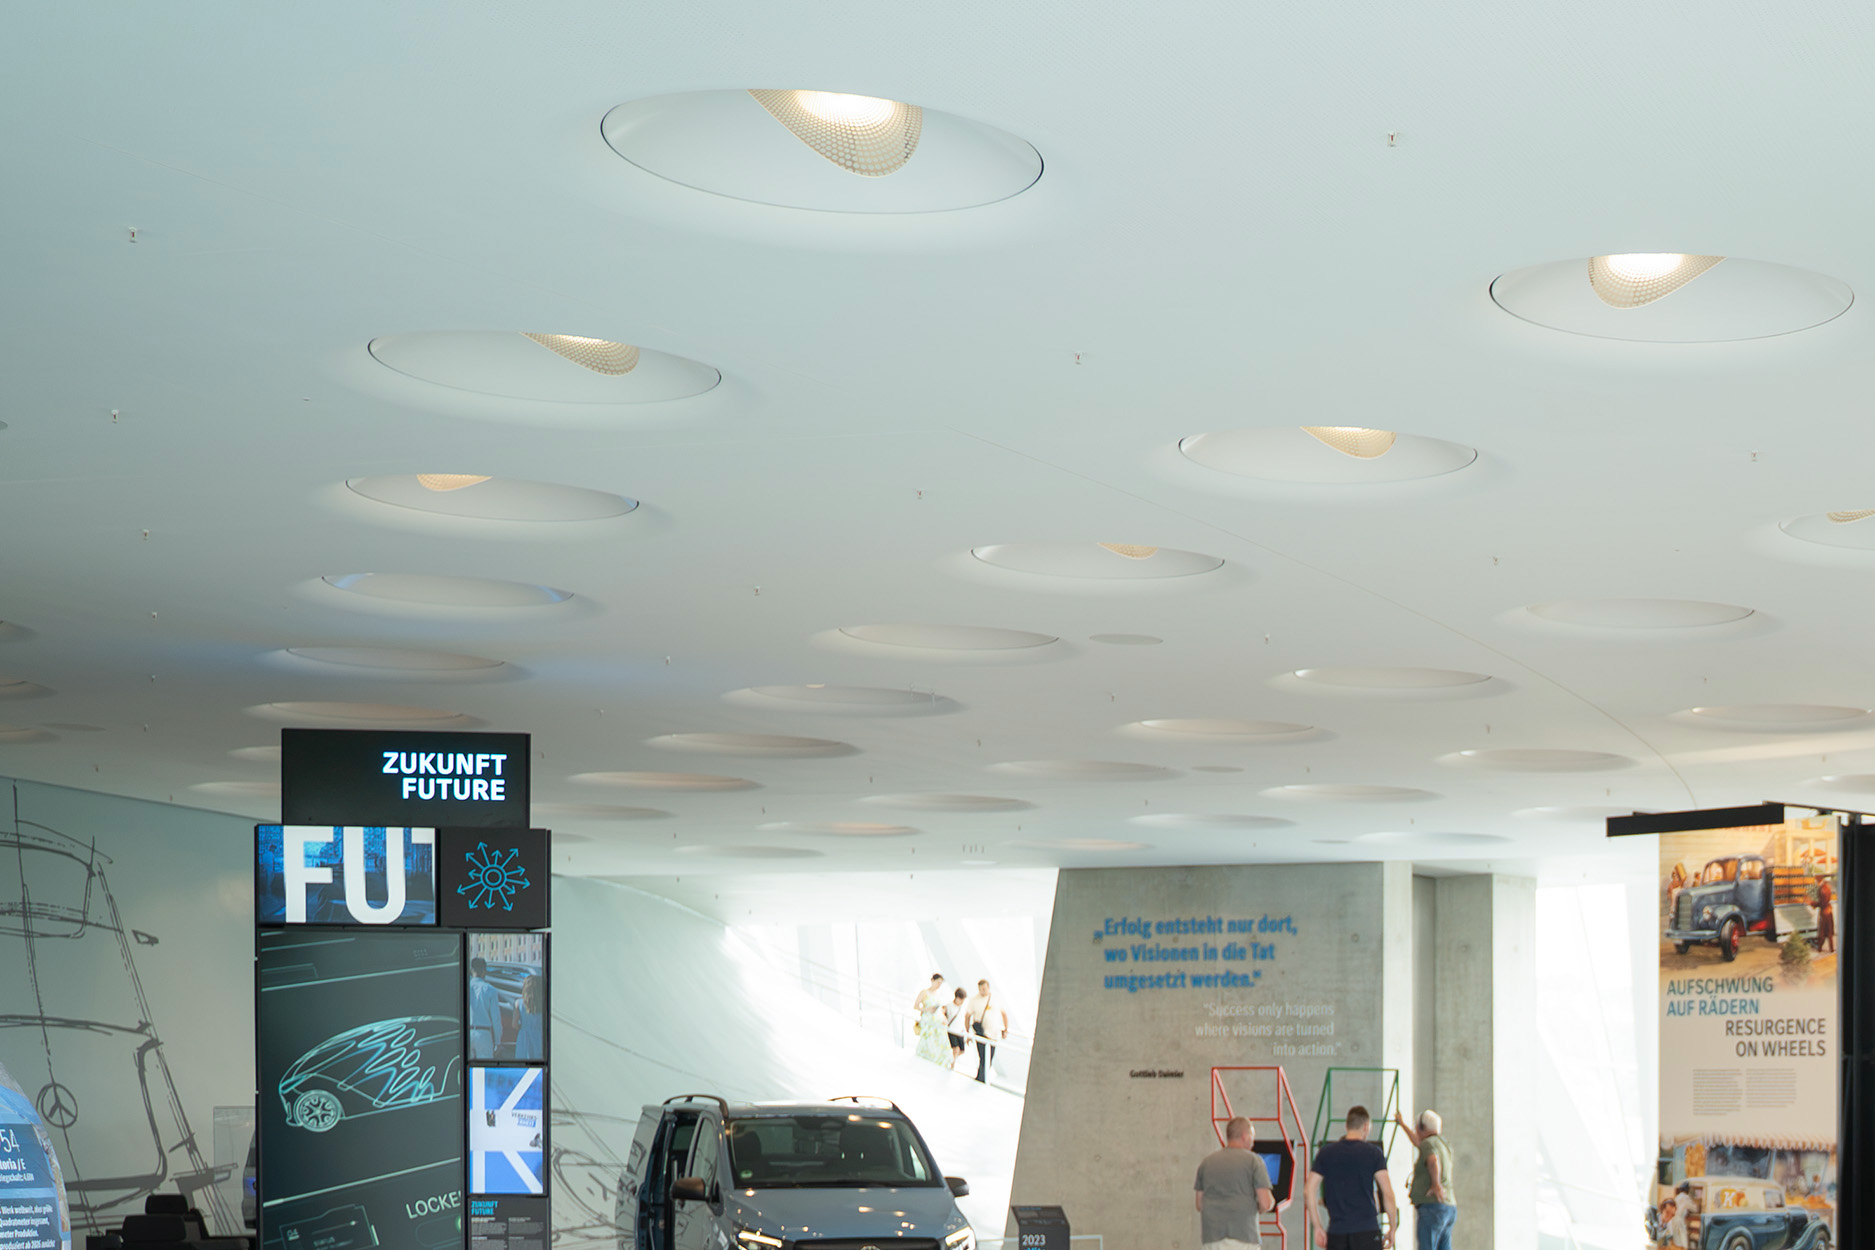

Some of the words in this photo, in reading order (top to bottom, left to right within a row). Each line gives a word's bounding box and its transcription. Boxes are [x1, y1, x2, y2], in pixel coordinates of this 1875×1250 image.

[382, 751, 507, 776] ZUKUNFT
[402, 777, 506, 801] FUTURE
[1155, 916, 1223, 936] entsteht
[1227, 919, 1254, 934] nur
[1257, 914, 1297, 936] dort,
[1104, 947, 1127, 962] wo
[1130, 944, 1199, 962] Visionen
[1203, 944, 1217, 961] in
[1222, 943, 1247, 961] die
[1251, 942, 1275, 960] Tat
[1104, 973, 1186, 993] umgesetzt
[1666, 976, 1774, 996] AUFSCHWUNG
[1258, 1002, 1283, 1018] only
[1285, 1001, 1335, 1018] happens
[1666, 999, 1695, 1016] AUF
[1698, 993, 1760, 1016] RÄDERN
[1195, 1023, 1229, 1037] where
[1232, 1022, 1272, 1036] visions
[1275, 1025, 1293, 1036] are
[1296, 1022, 1335, 1036] turned
[1725, 1018, 1826, 1037] RESURGENCE
[1272, 1042, 1296, 1056] into
[1735, 1040, 1758, 1057] ON
[1761, 1039, 1826, 1057] WHEELS
[405, 1190, 461, 1219] LOCKE
[1022, 1234, 1046, 1246] 2023
